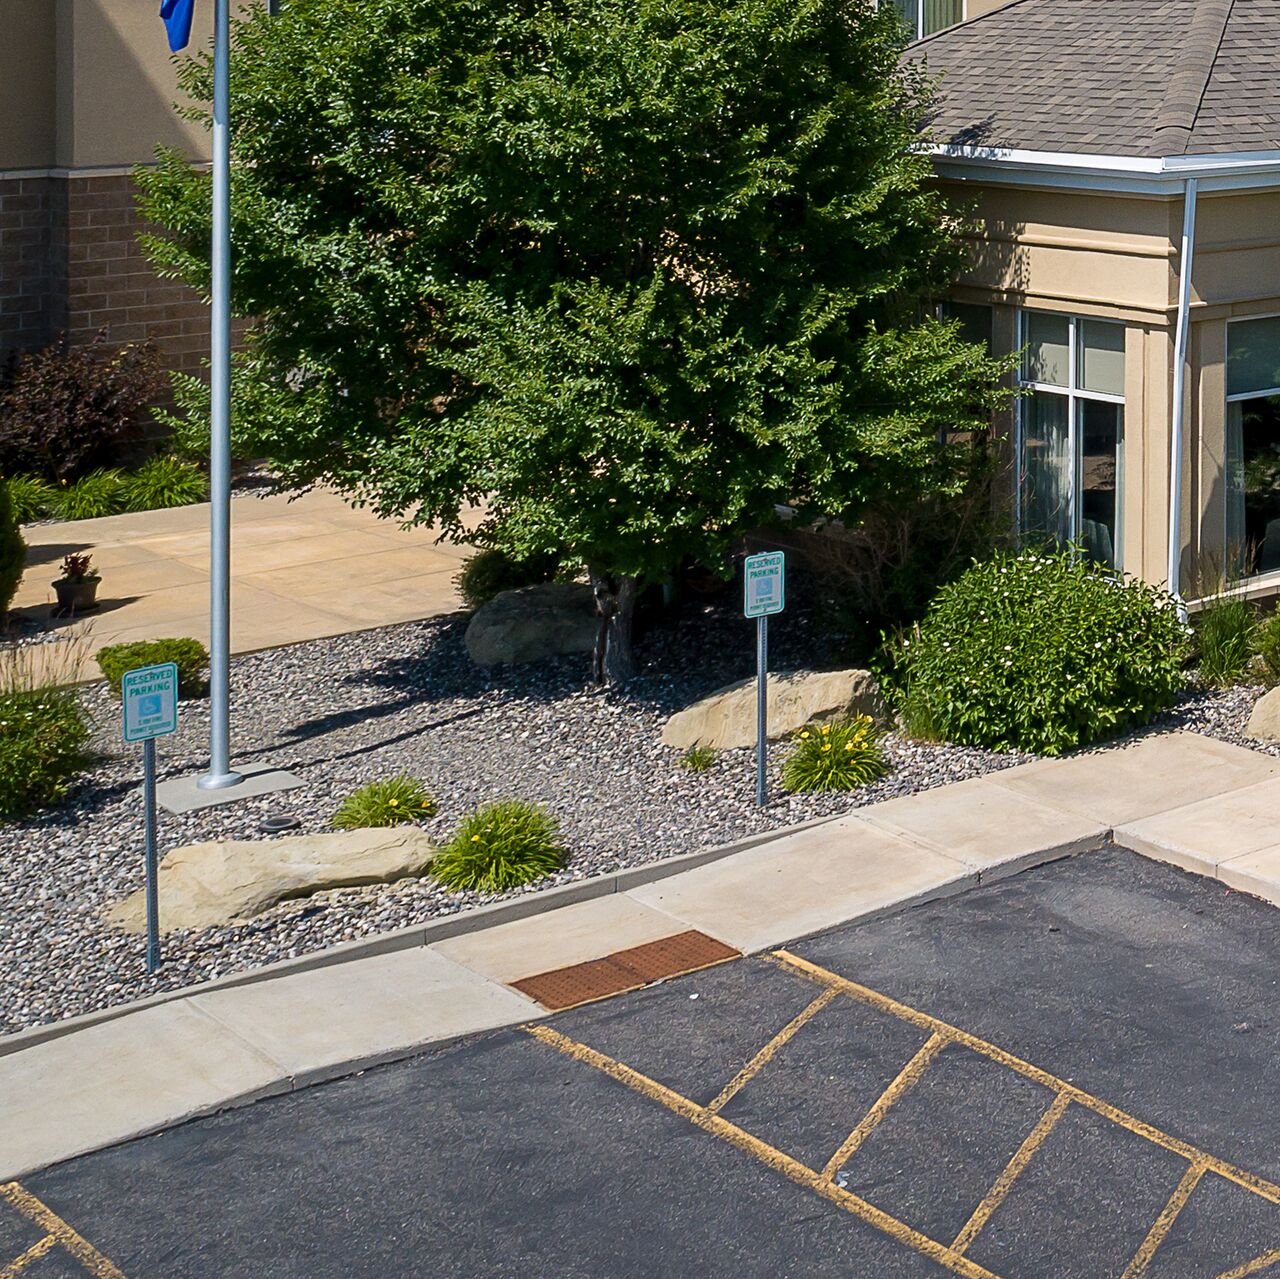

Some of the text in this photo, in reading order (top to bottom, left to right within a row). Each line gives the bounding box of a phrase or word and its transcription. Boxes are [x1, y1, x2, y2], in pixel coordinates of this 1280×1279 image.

[747, 557, 781, 568] RESERVED
[750, 567, 779, 578] PARKING
[127, 670, 172, 686] RESERVED
[129, 681, 170, 697] PARKING
